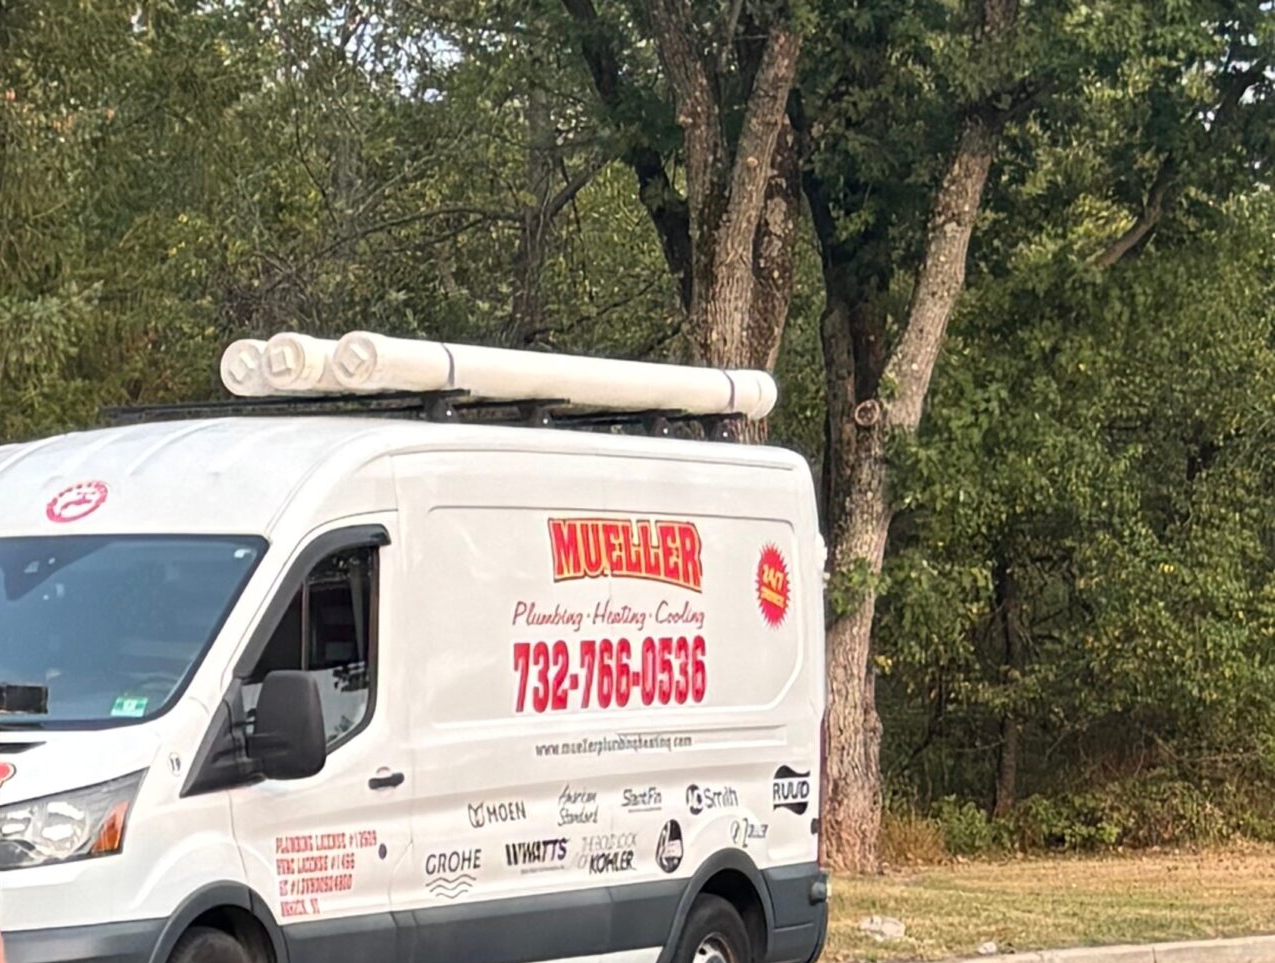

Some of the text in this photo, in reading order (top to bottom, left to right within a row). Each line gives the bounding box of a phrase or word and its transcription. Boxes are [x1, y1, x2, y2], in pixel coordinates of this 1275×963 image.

[549, 518, 702, 592] MUELLER
[512, 599, 706, 632] Plumbing Heating Cooling
[513, 635, 706, 713] 732-766-0536
[704, 786, 739, 809] Smith
[773, 781, 810, 801] RUUD
[486, 801, 527, 824] MOEN
[425, 849, 482, 875] GROHE
[505, 838, 568, 866] WATTS
[589, 850, 637, 875] KOHLER
